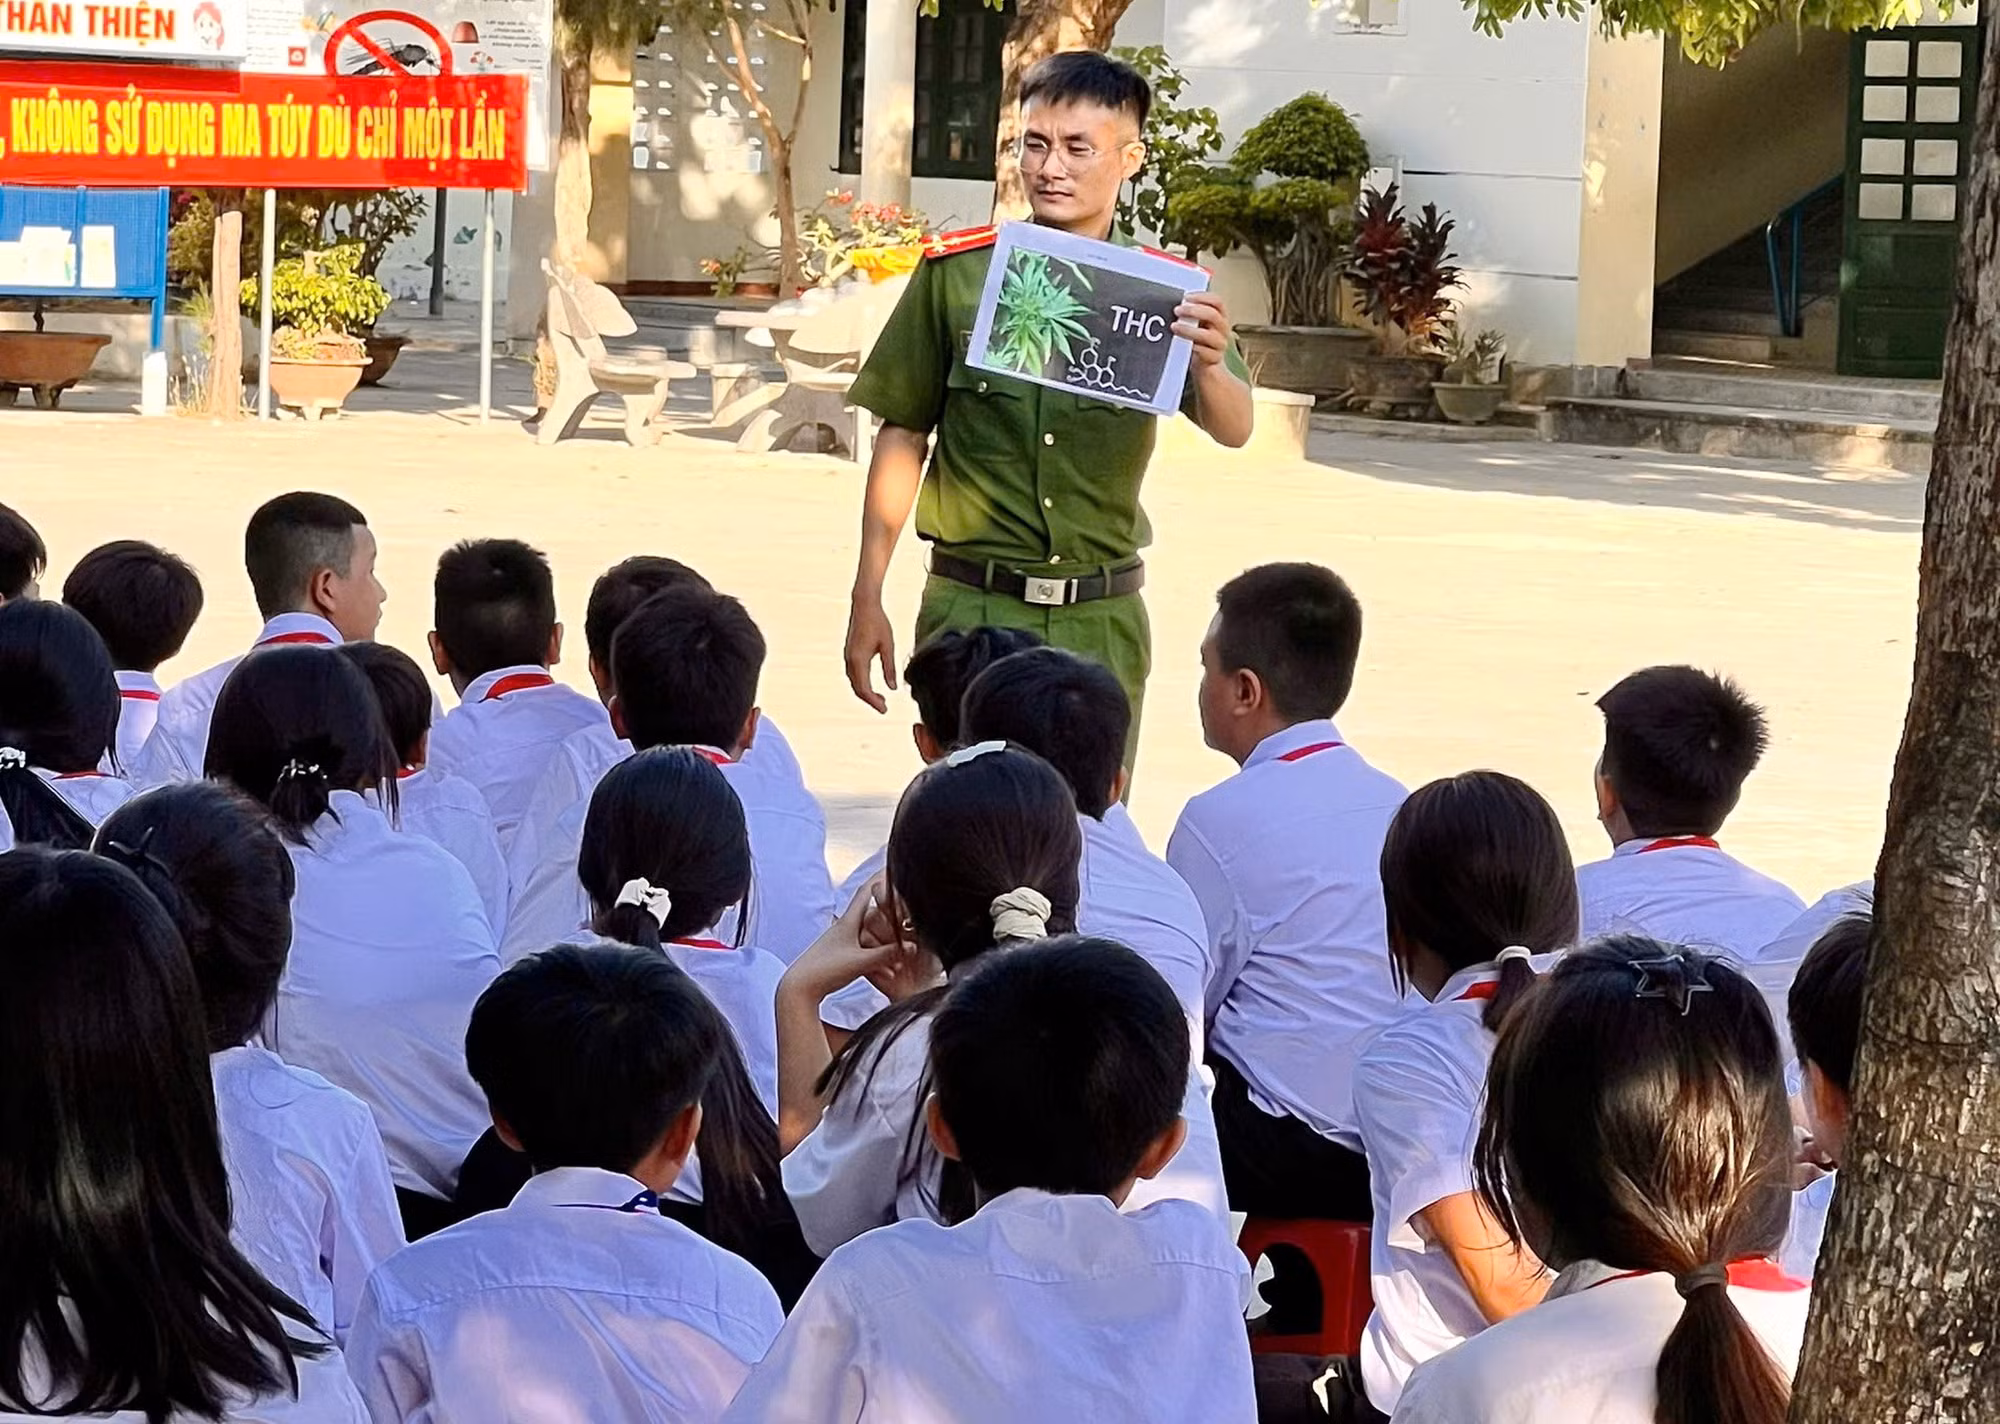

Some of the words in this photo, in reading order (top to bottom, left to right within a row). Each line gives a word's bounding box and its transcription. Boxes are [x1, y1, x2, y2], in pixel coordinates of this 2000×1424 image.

[84, 1, 175, 46] THIỆN
[11, 86, 98, 154] KHÔNG
[105, 83, 143, 156] SỬ
[146, 101, 215, 169] DỤNG
[222, 103, 262, 157] MA
[267, 93, 312, 159] TÚY
[318, 95, 351, 159] DÙ
[357, 89, 397, 159] CHỈ
[403, 96, 454, 171] MỘT
[1110, 305, 1166, 342] THC
